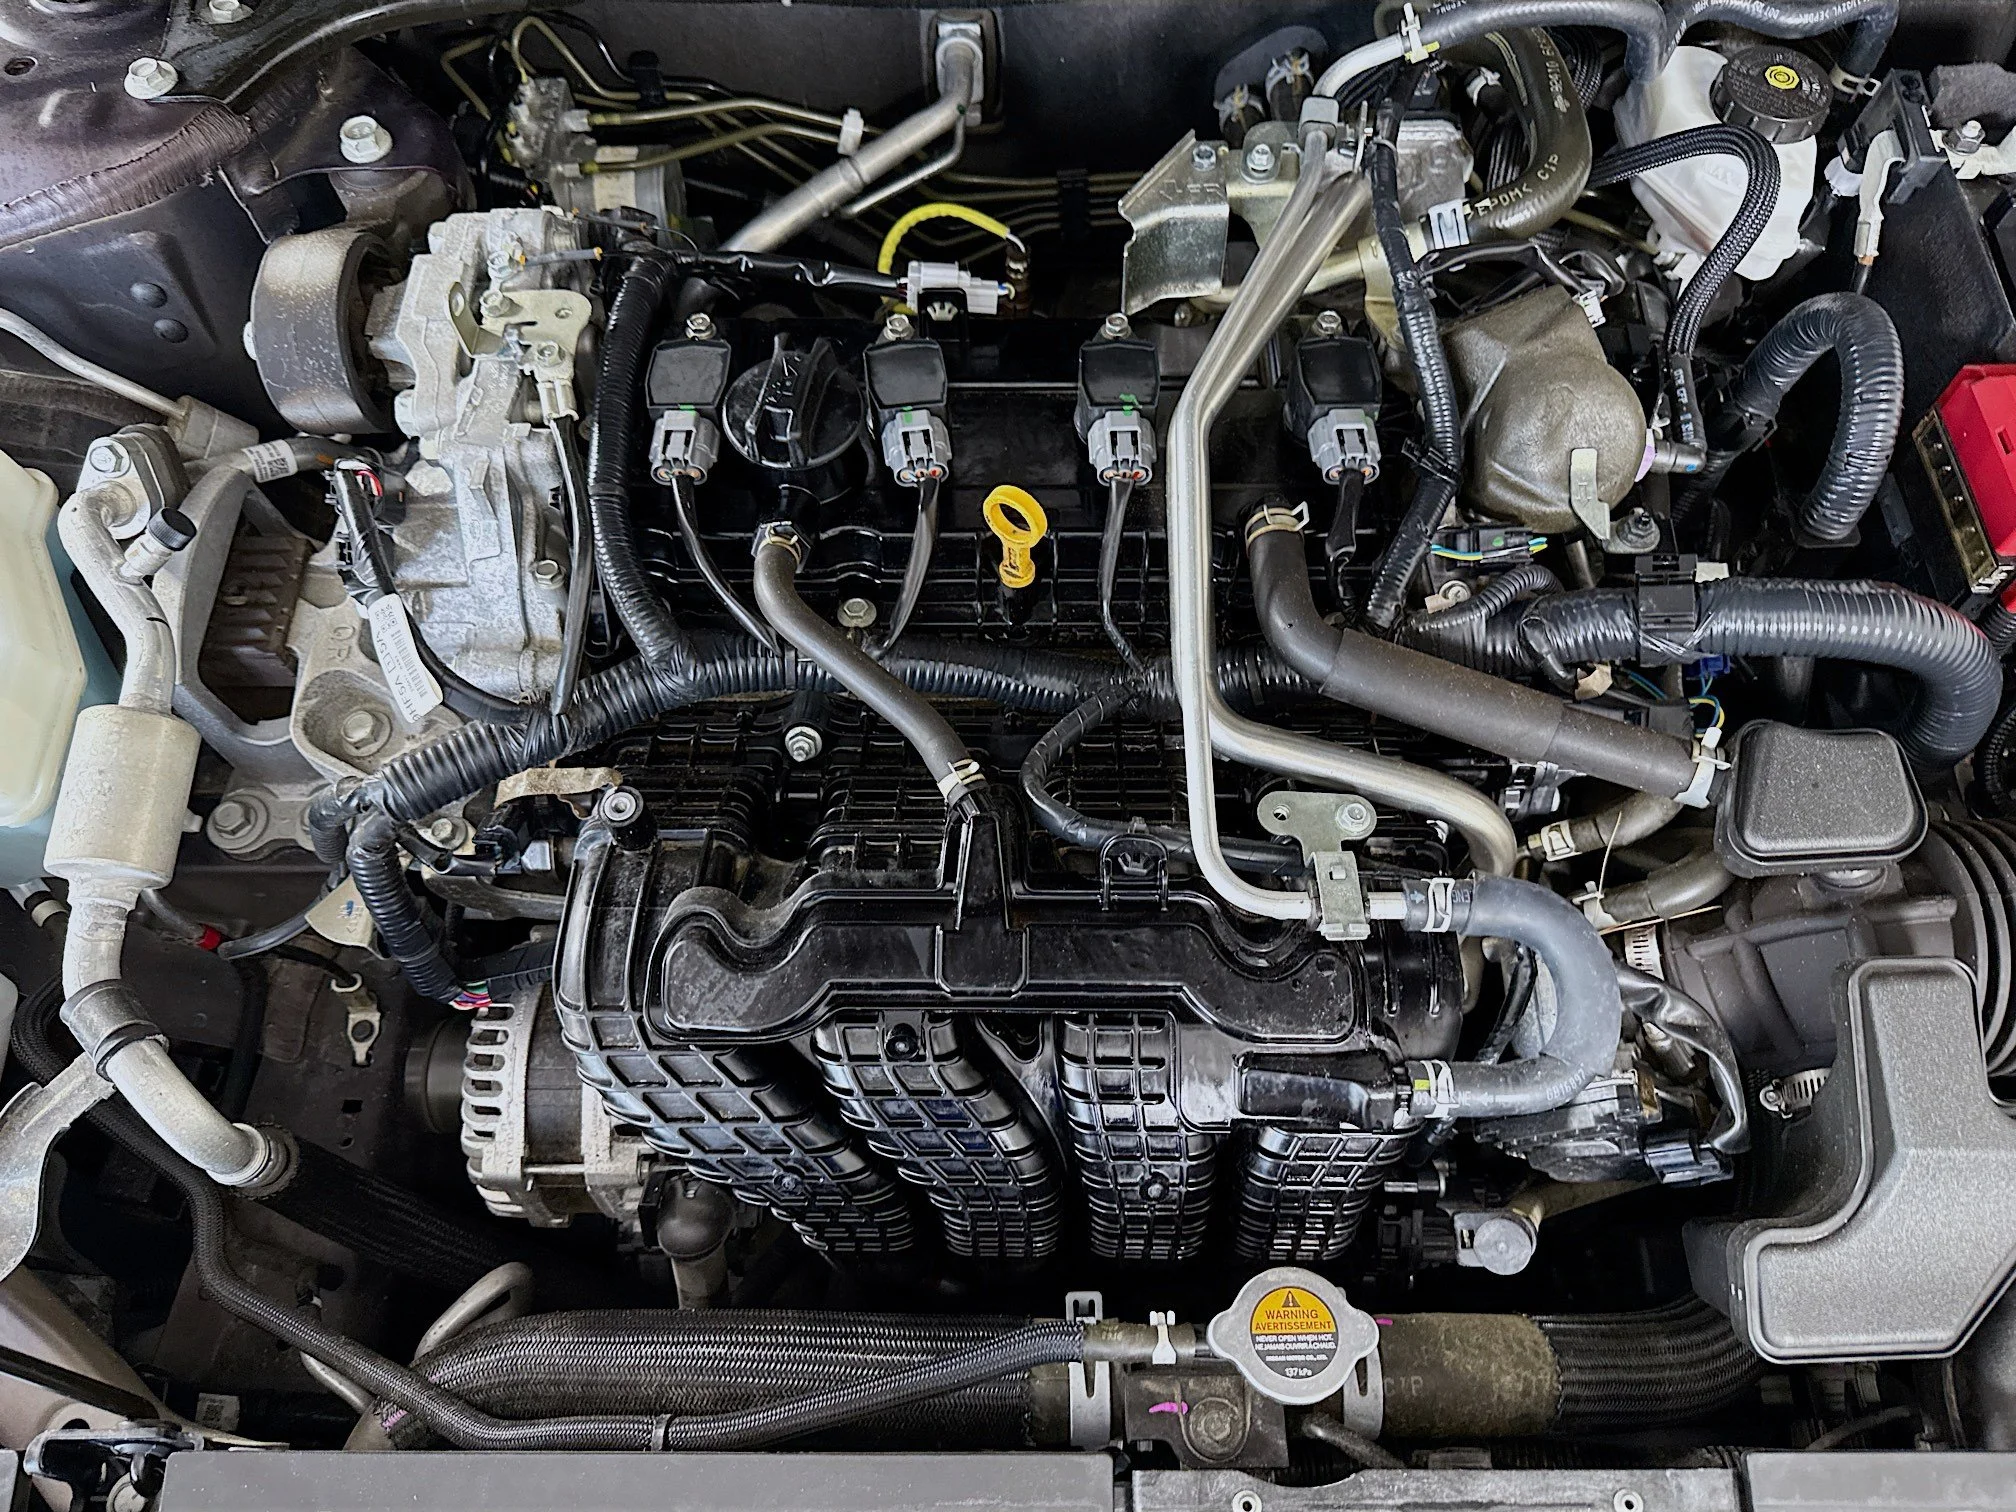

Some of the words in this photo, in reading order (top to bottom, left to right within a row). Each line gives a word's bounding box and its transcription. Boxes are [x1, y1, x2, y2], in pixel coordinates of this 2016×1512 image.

[1265, 1309, 1319, 1320] WARNING
[1255, 1321, 1331, 1331] AVERTISSEMENT
[1297, 1334, 1318, 1342] WHEN
